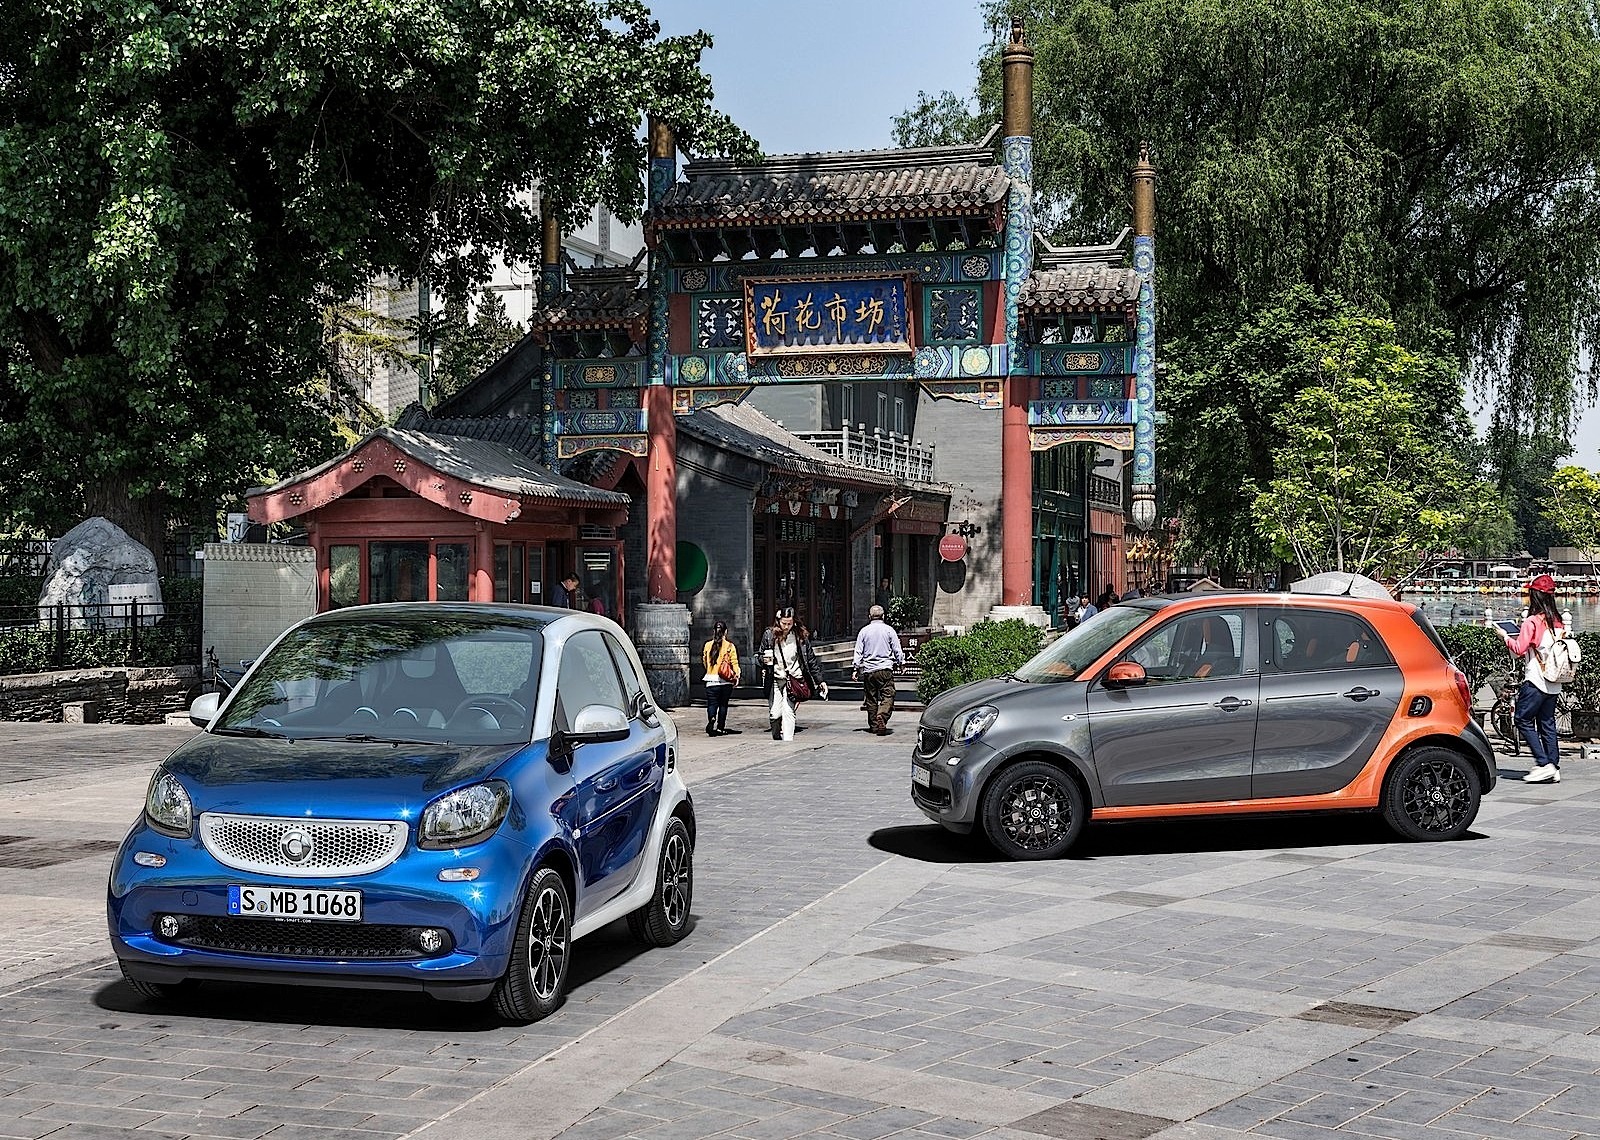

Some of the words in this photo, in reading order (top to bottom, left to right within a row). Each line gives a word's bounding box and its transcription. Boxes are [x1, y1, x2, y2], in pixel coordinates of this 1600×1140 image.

[242, 889, 255, 911] S
[270, 891, 298, 914] MB
[302, 893, 357, 916] 1068
